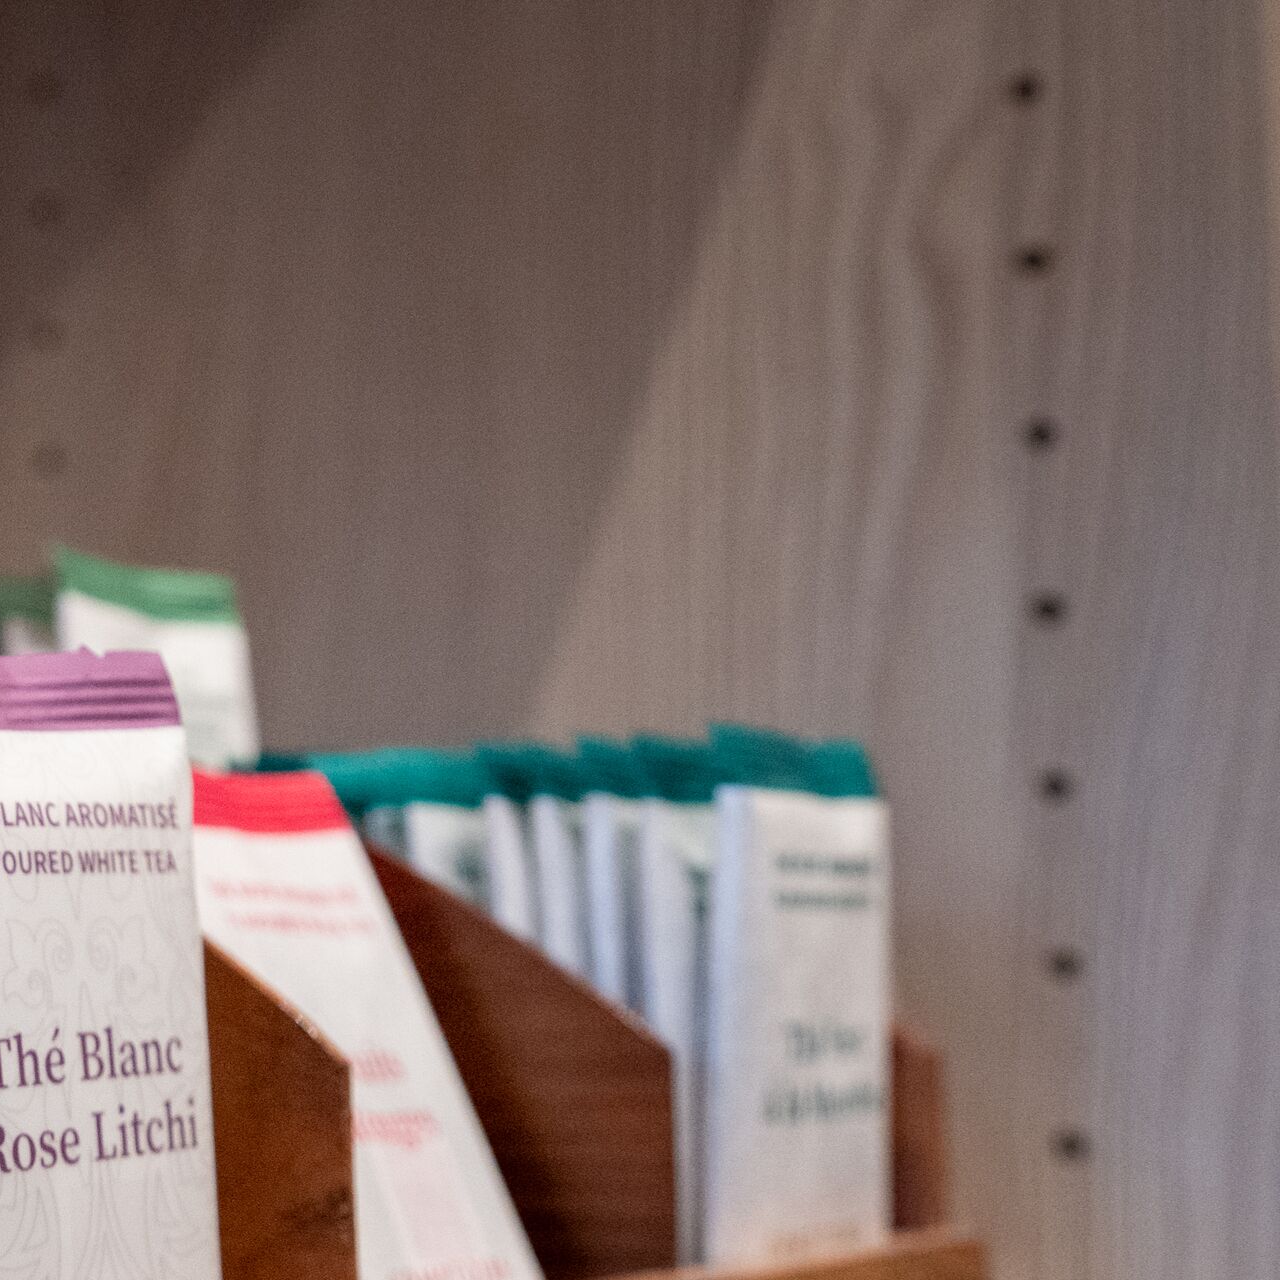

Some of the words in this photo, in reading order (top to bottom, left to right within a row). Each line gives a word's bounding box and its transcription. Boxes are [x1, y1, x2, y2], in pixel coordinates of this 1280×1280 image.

[65, 797, 180, 829] AROMATISÉ
[78, 851, 139, 874] WHITE
[144, 852, 178, 874] TEA
[77, 1026, 182, 1081] Blanc
[92, 1097, 198, 1161] Litchi
